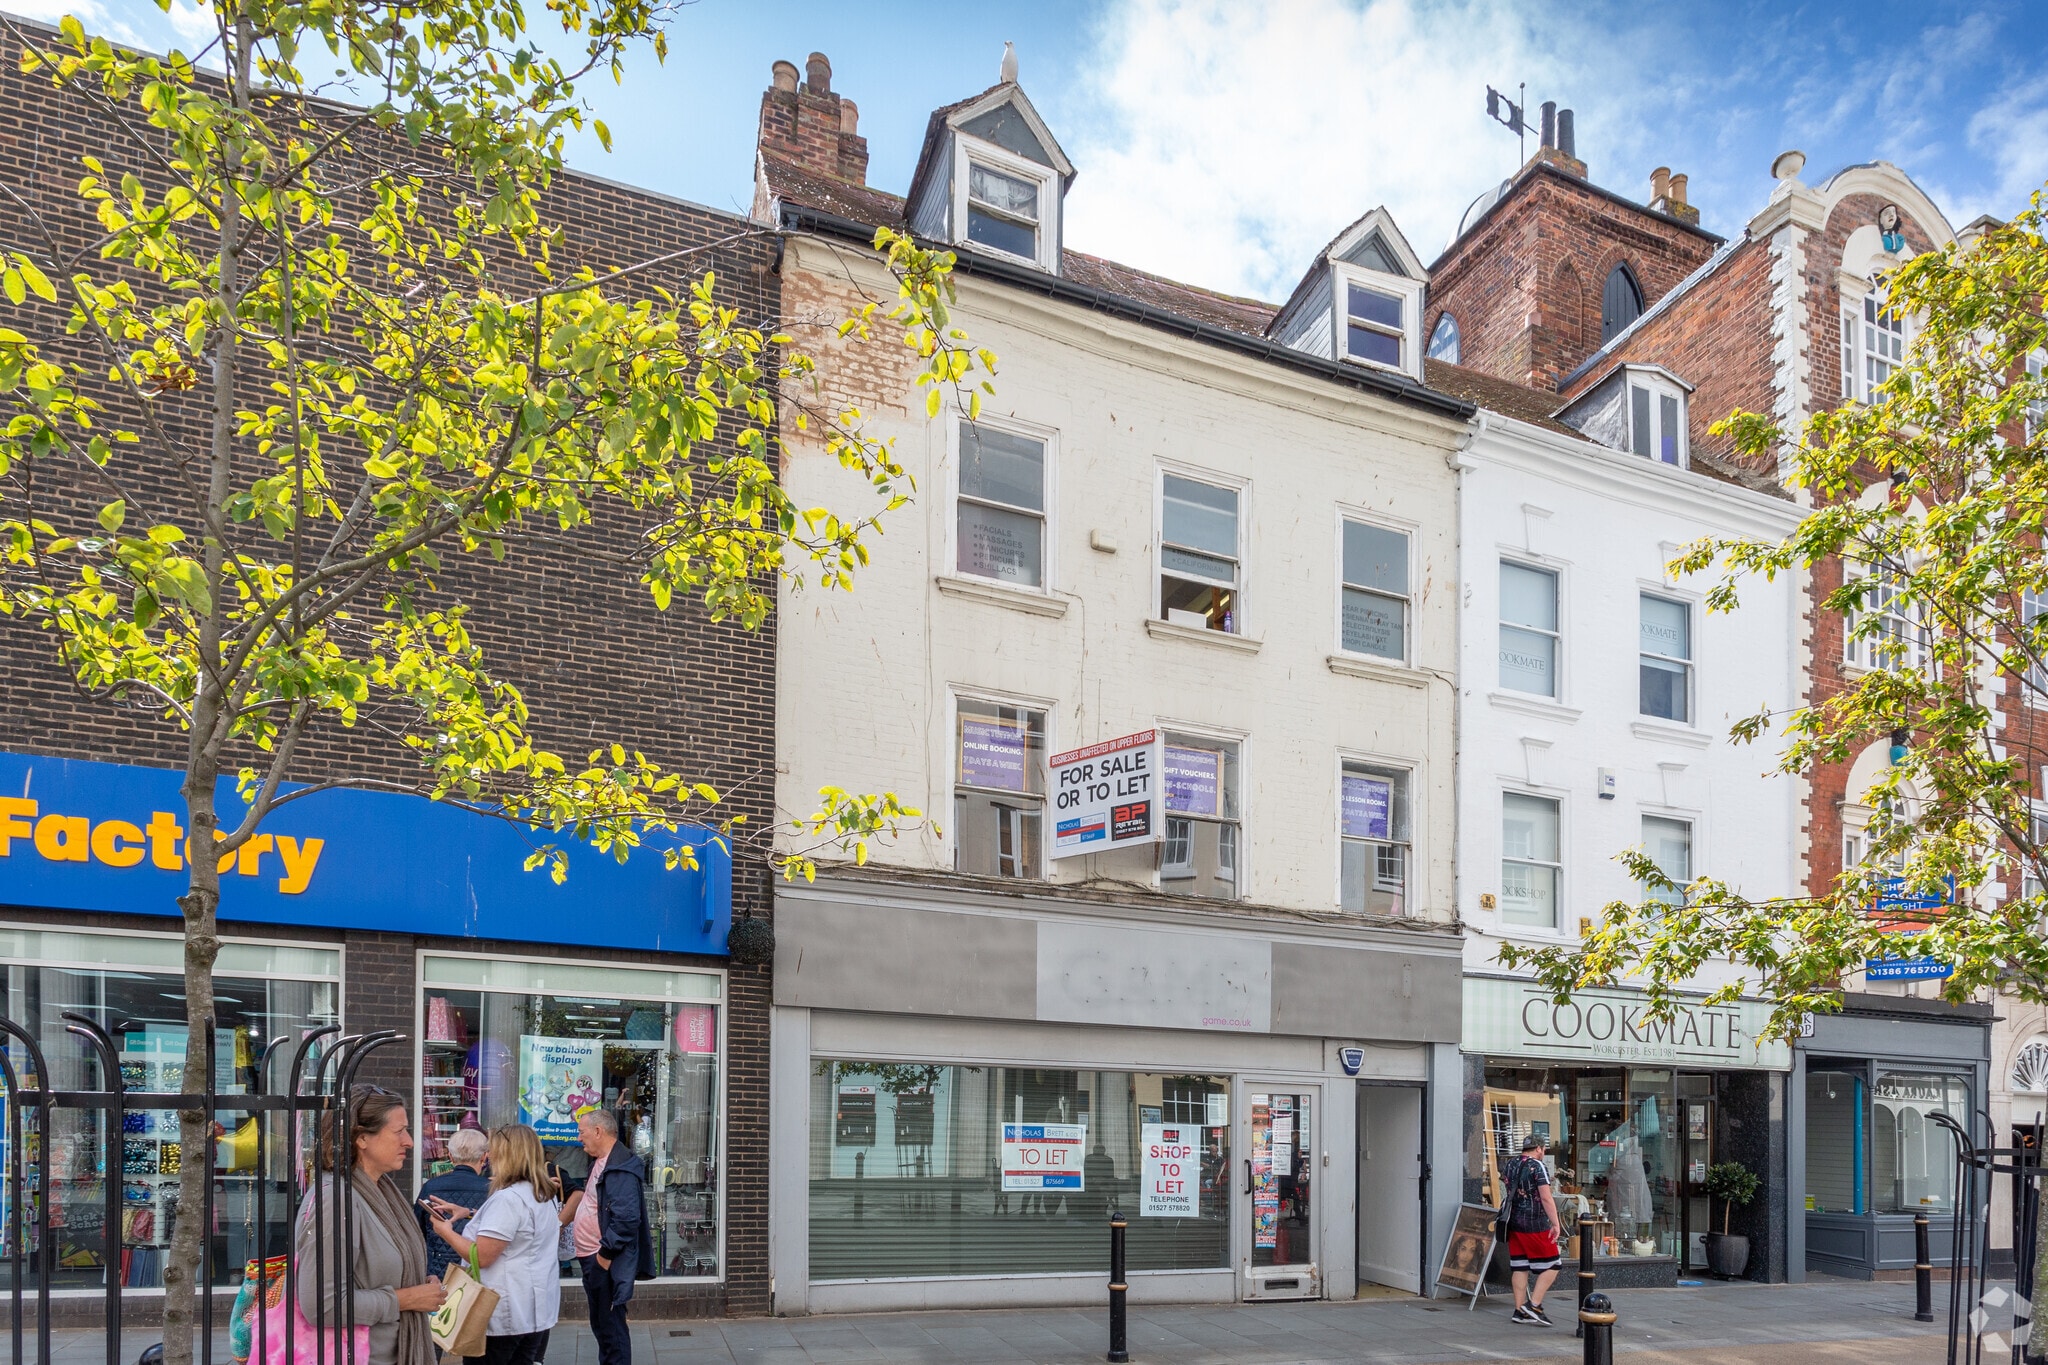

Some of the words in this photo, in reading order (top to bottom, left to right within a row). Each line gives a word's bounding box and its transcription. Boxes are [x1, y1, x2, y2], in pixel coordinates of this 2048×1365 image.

[979, 524, 1012, 538] FACIALS
[979, 534, 1023, 549] MASSAGES
[979, 543, 1025, 559] MANICURES
[1177, 559, 1223, 574] CALIFORNIAN
[963, 741, 989, 751] ONLINE
[989, 744, 1024, 756] BOOKING.
[1051, 751, 1079, 766] BUSINESSES
[1109, 742, 1117, 751] ON
[1117, 737, 1133, 750] UPPER
[1133, 732, 1154, 746] FLOORS
[969, 756, 992, 767] DAYS
[1060, 764, 1094, 788] FOR
[1100, 751, 1147, 778] SALE
[1164, 766, 1178, 775] GIFT
[1180, 768, 1217, 780] VOUCHERS.
[1057, 789, 1080, 810] OR
[1086, 782, 1110, 803] TO
[1117, 774, 1150, 797] LET
[1346, 795, 1366, 804] LESSON
[1366, 798, 1387, 807] ROOMS.
[1881, 902, 1924, 911] KGHT
[1869, 967, 1902, 976] 01386
[1904, 965, 1946, 975] 765700
[1202, 1017, 1252, 1027] game.co.uk
[1521, 997, 1741, 1050] COOKMATE
[531, 1043, 553, 1053] New
[555, 1044, 593, 1055] balloon
[541, 1054, 582, 1066] displays
[1007, 1128, 1042, 1137] NICHOLAS
[1047, 1129, 1064, 1138] BRETT
[1018, 1148, 1041, 1165] TO
[1046, 1149, 1069, 1166] LET
[1150, 1145, 1192, 1159] SHOP
[1160, 1163, 1181, 1177] TO
[1156, 1180, 1185, 1194] LET
[1150, 1195, 1190, 1203] TELEPHONE
[1168, 1204, 1191, 1212] 578820
[67, 1212, 98, 1223] Back
[70, 1220, 105, 1230] Schoo
